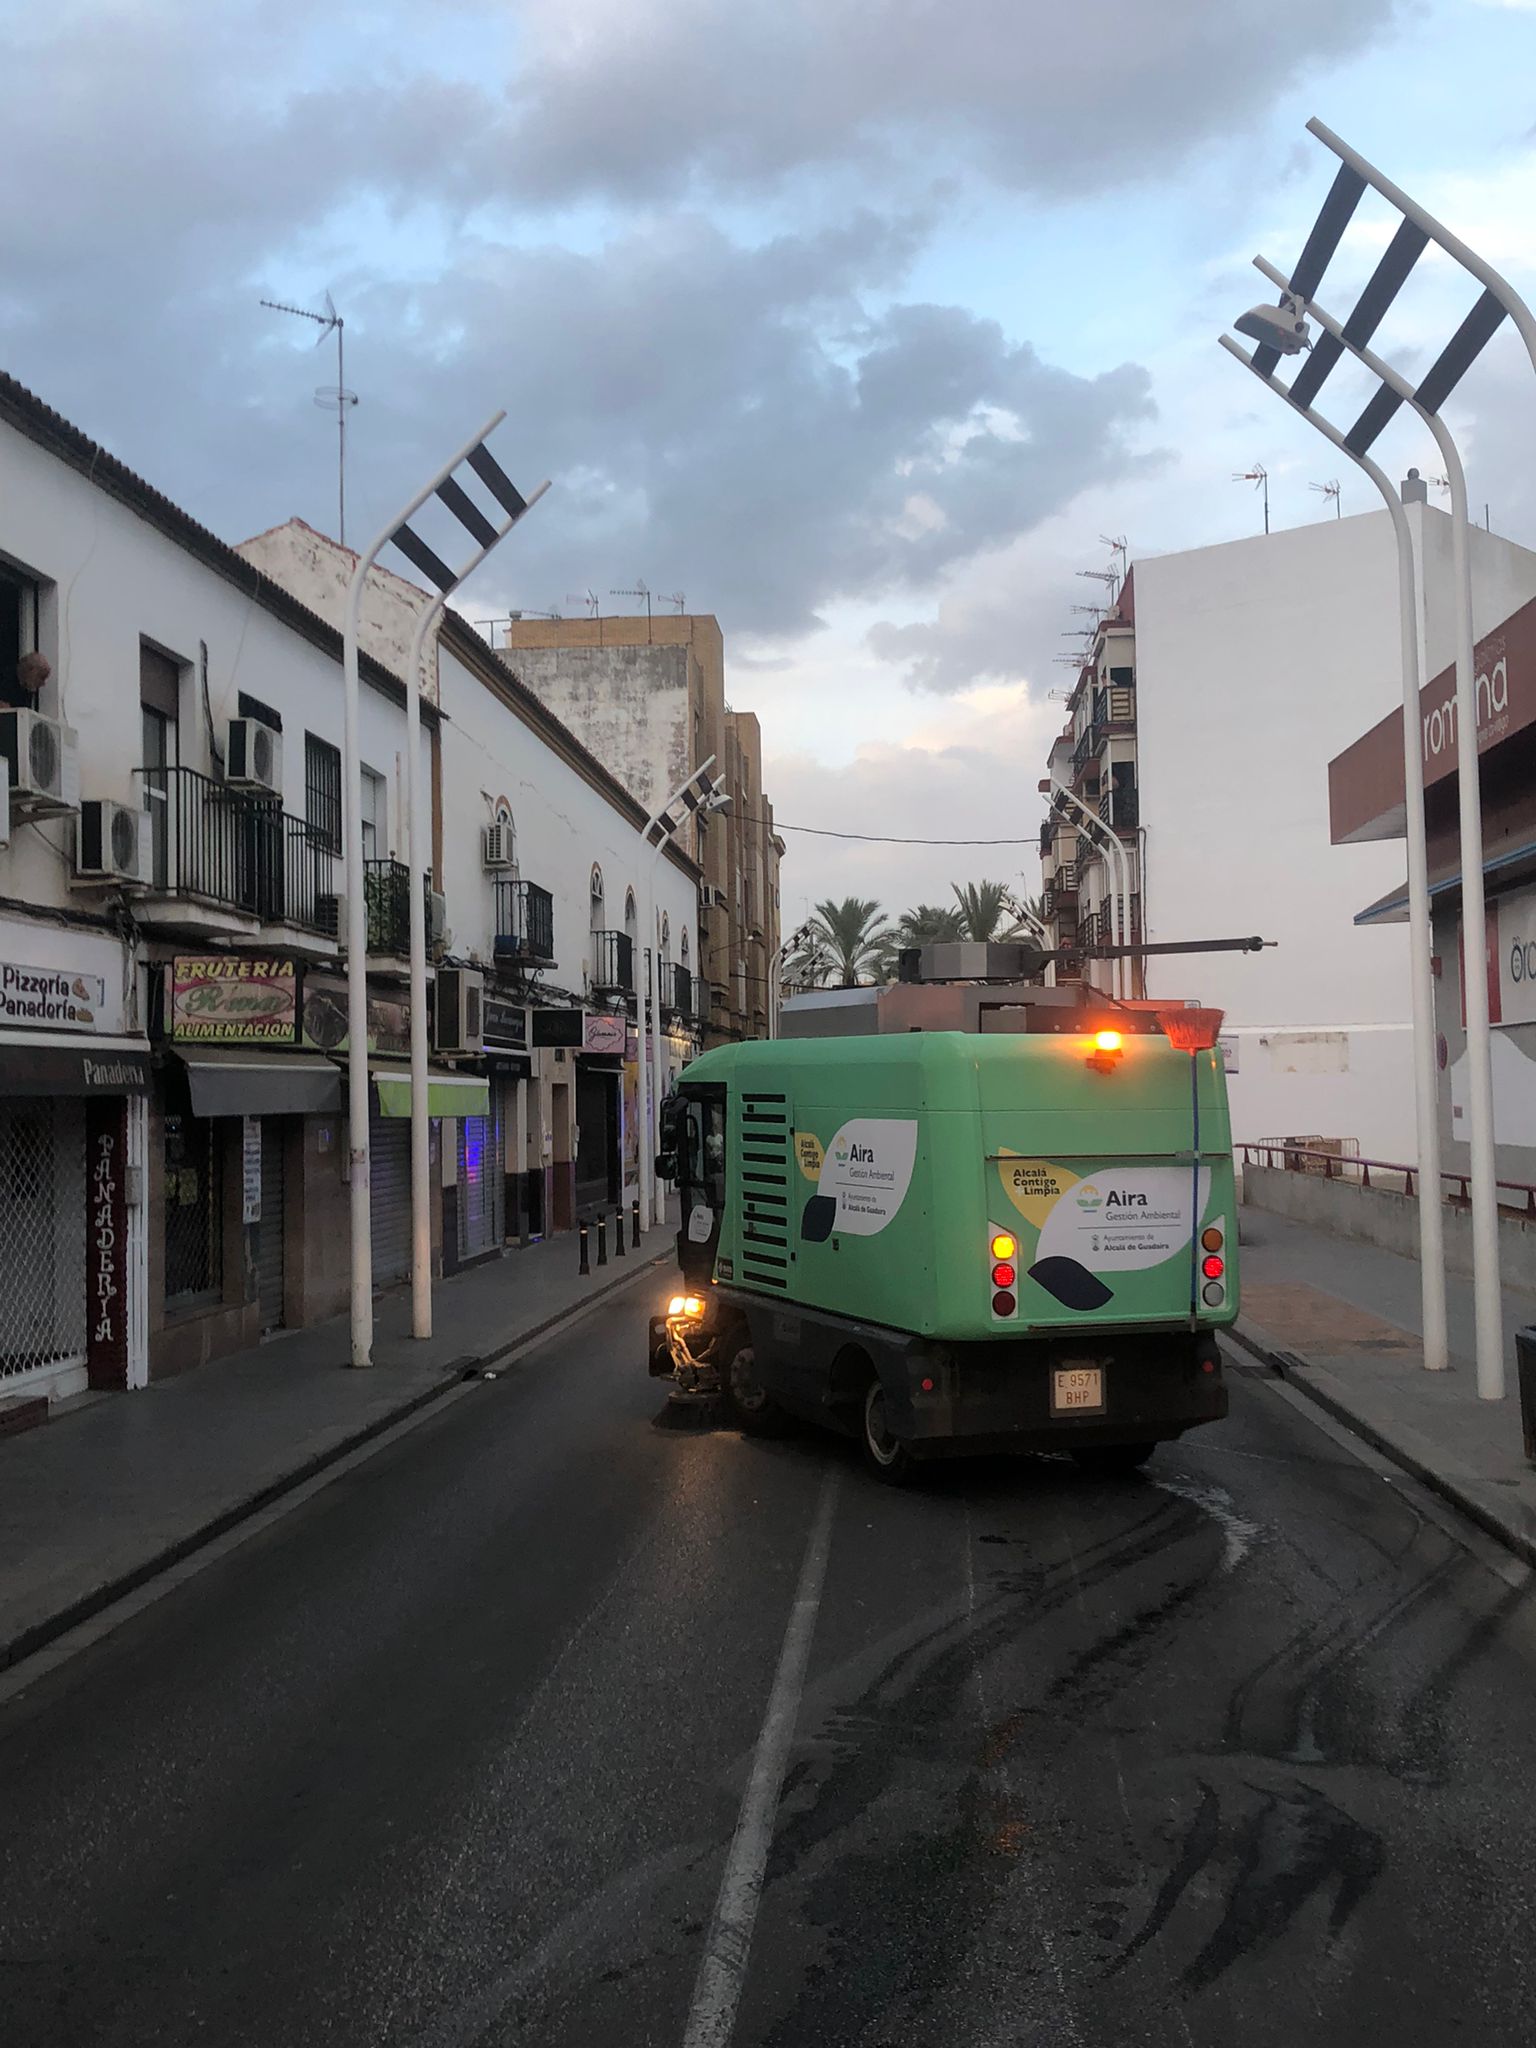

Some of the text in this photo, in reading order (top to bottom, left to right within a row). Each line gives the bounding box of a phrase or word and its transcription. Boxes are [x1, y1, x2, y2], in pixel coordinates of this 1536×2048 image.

[1423, 656, 1508, 762] romna
[849, 1143, 875, 1163] Aira
[1013, 1168, 1048, 1178] Alcalá
[1013, 1178, 1057, 1189] Contigo
[1024, 1187, 1061, 1197] Limpia
[1106, 1190, 1148, 1207] Aira
[1105, 1210, 1181, 1221] Gestión Ambiental
[1103, 1234, 1145, 1242] Ayuntamiento
[1058, 1373, 1098, 1388] E 9571
[1066, 1391, 1090, 1404] BHP
